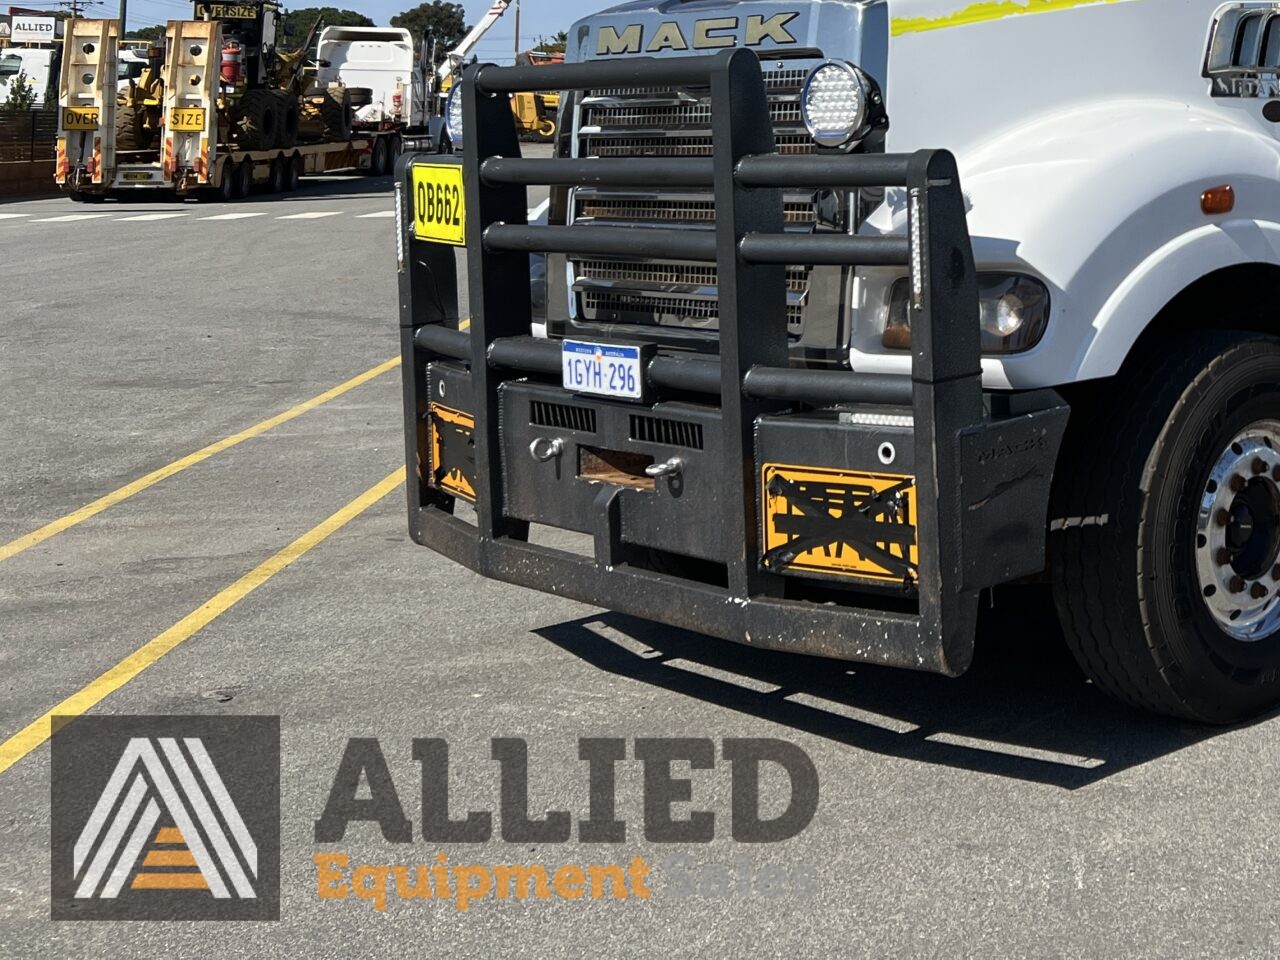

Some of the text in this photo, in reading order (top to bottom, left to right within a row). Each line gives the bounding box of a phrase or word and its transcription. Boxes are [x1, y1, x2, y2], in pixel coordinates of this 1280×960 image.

[15, 23, 53, 32] ALLIED
[596, 11, 800, 56] MACK
[66, 113, 98, 125] OVER
[171, 113, 202, 126] SIZE
[417, 181, 460, 227] QB662
